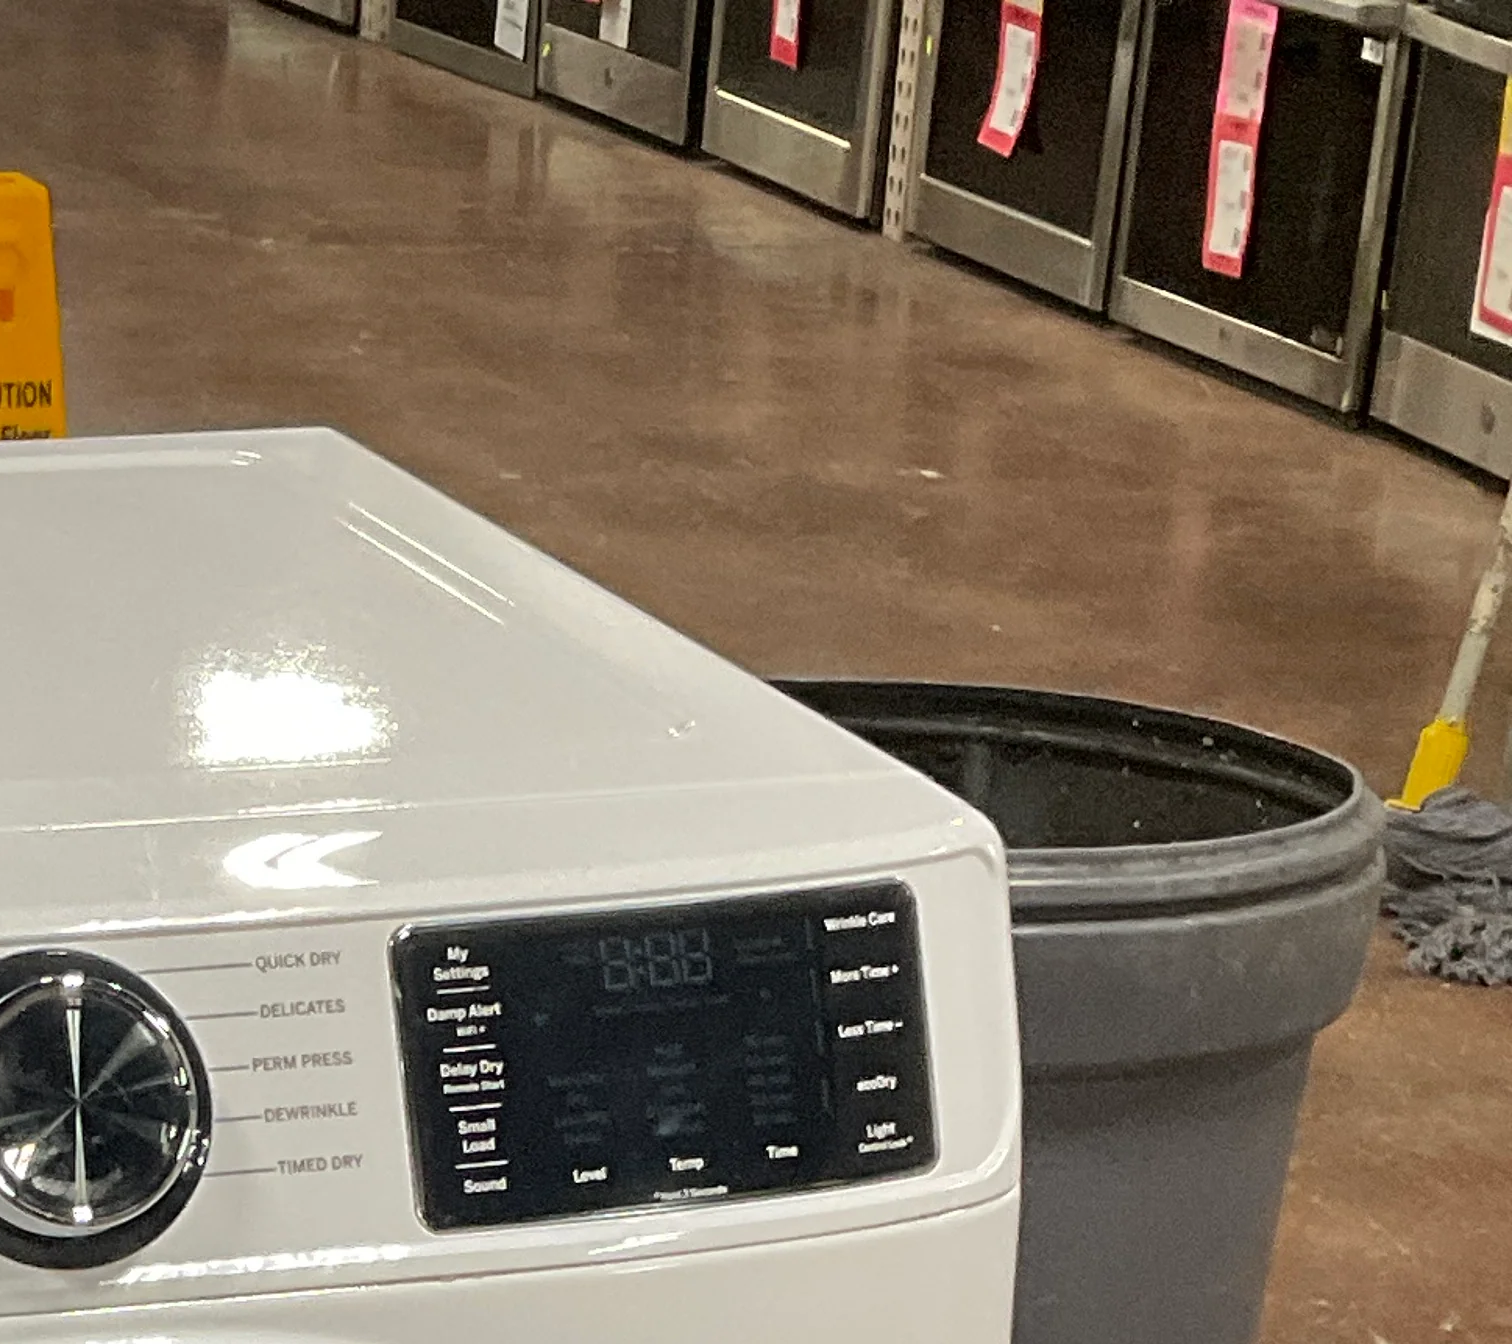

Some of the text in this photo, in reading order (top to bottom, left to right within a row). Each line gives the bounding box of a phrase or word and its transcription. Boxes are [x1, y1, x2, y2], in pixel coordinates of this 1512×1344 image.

[868, 911, 895, 926] Care
[255, 951, 341, 973] QUICK DRY
[447, 946, 469, 963] My
[433, 966, 489, 981] Settings
[830, 969, 860, 983] More
[860, 965, 889, 979] Time
[260, 998, 345, 1018] DELICATES
[427, 1001, 502, 1022] Damp Alert
[838, 1024, 864, 1038] Less
[865, 1020, 894, 1034] Time
[252, 1051, 353, 1072] PERM PRESS
[440, 1059, 504, 1078] Delay Dry
[264, 1101, 358, 1123] DEWRINKLE
[458, 1118, 497, 1135] Small
[866, 1122, 896, 1139] Light
[462, 1137, 497, 1153] Load
[766, 1145, 799, 1159] Time
[277, 1154, 363, 1175] TIMED DRY
[669, 1157, 705, 1171] Temp
[573, 1167, 608, 1184] Level
[464, 1177, 508, 1194] Sound
